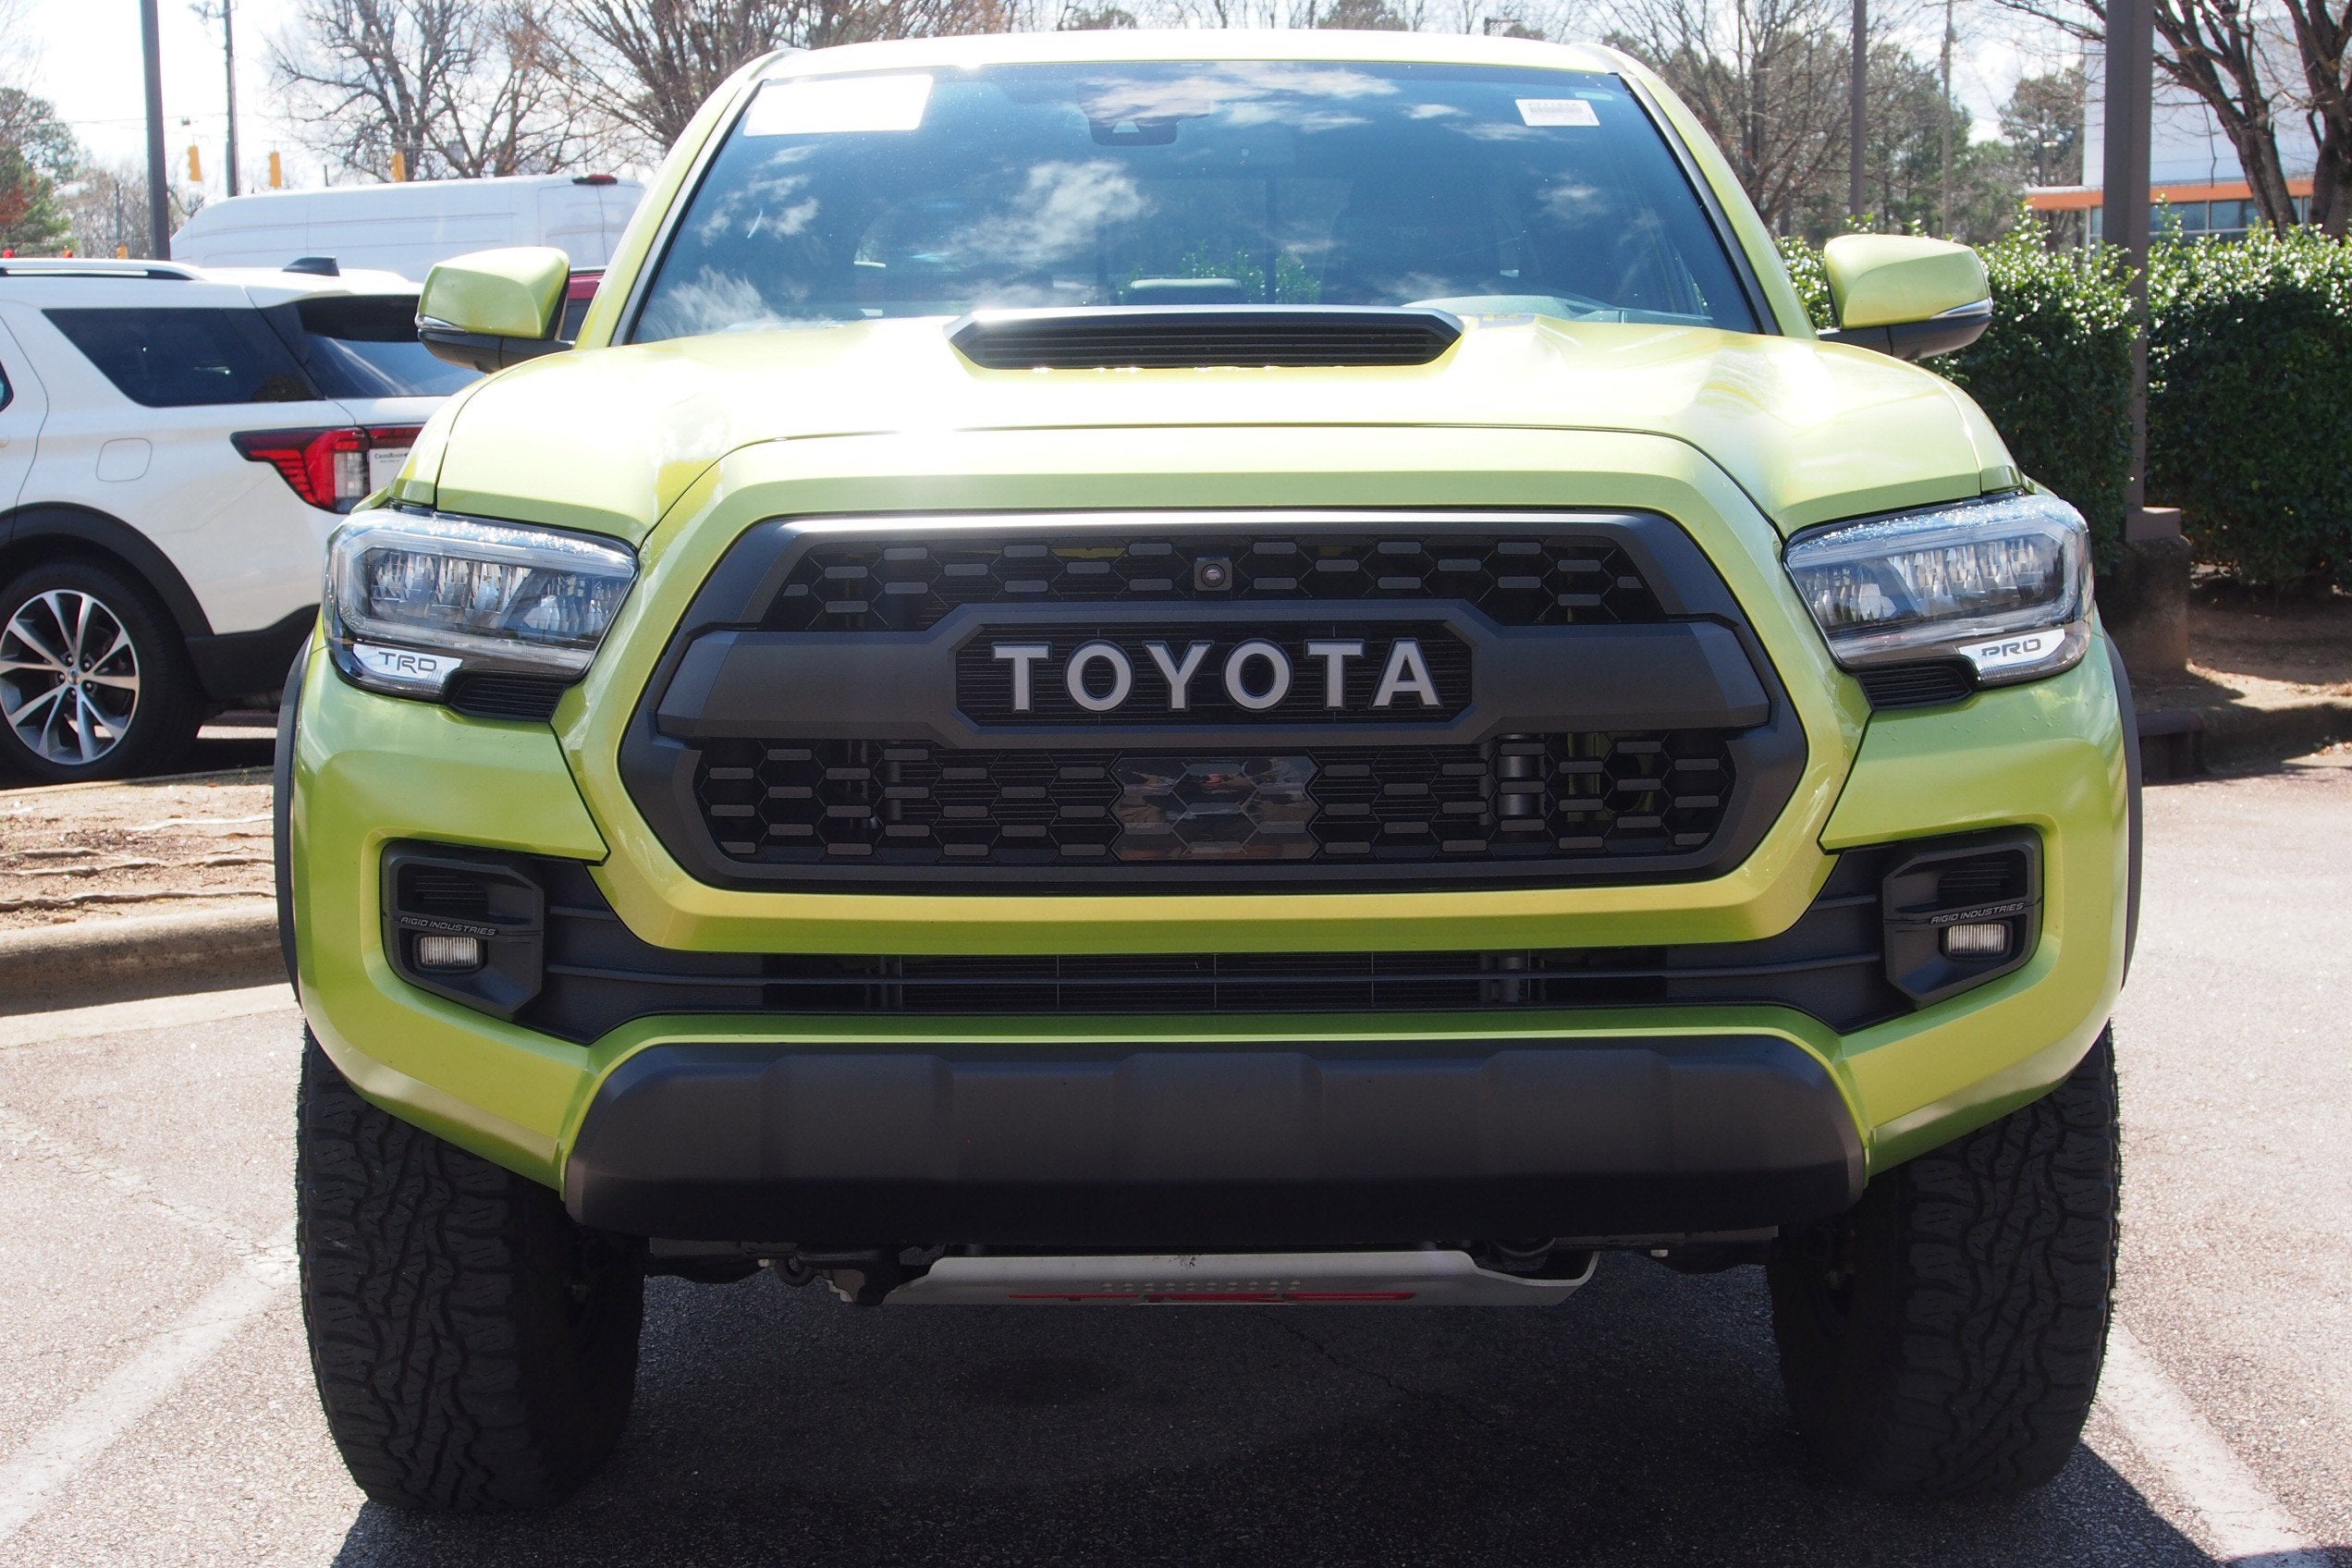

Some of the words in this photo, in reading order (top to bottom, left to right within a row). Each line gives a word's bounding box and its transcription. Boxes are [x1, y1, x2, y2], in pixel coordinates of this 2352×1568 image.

[1981, 638, 2042, 657] PRO
[378, 651, 437, 674] TRD
[991, 639, 1443, 712] TOYOTA
[1930, 913, 1959, 925] RIGID
[1960, 902, 2025, 919] INDUSTRIES
[400, 916, 429, 927] RIGID
[429, 921, 497, 937] INDUSTRIES
